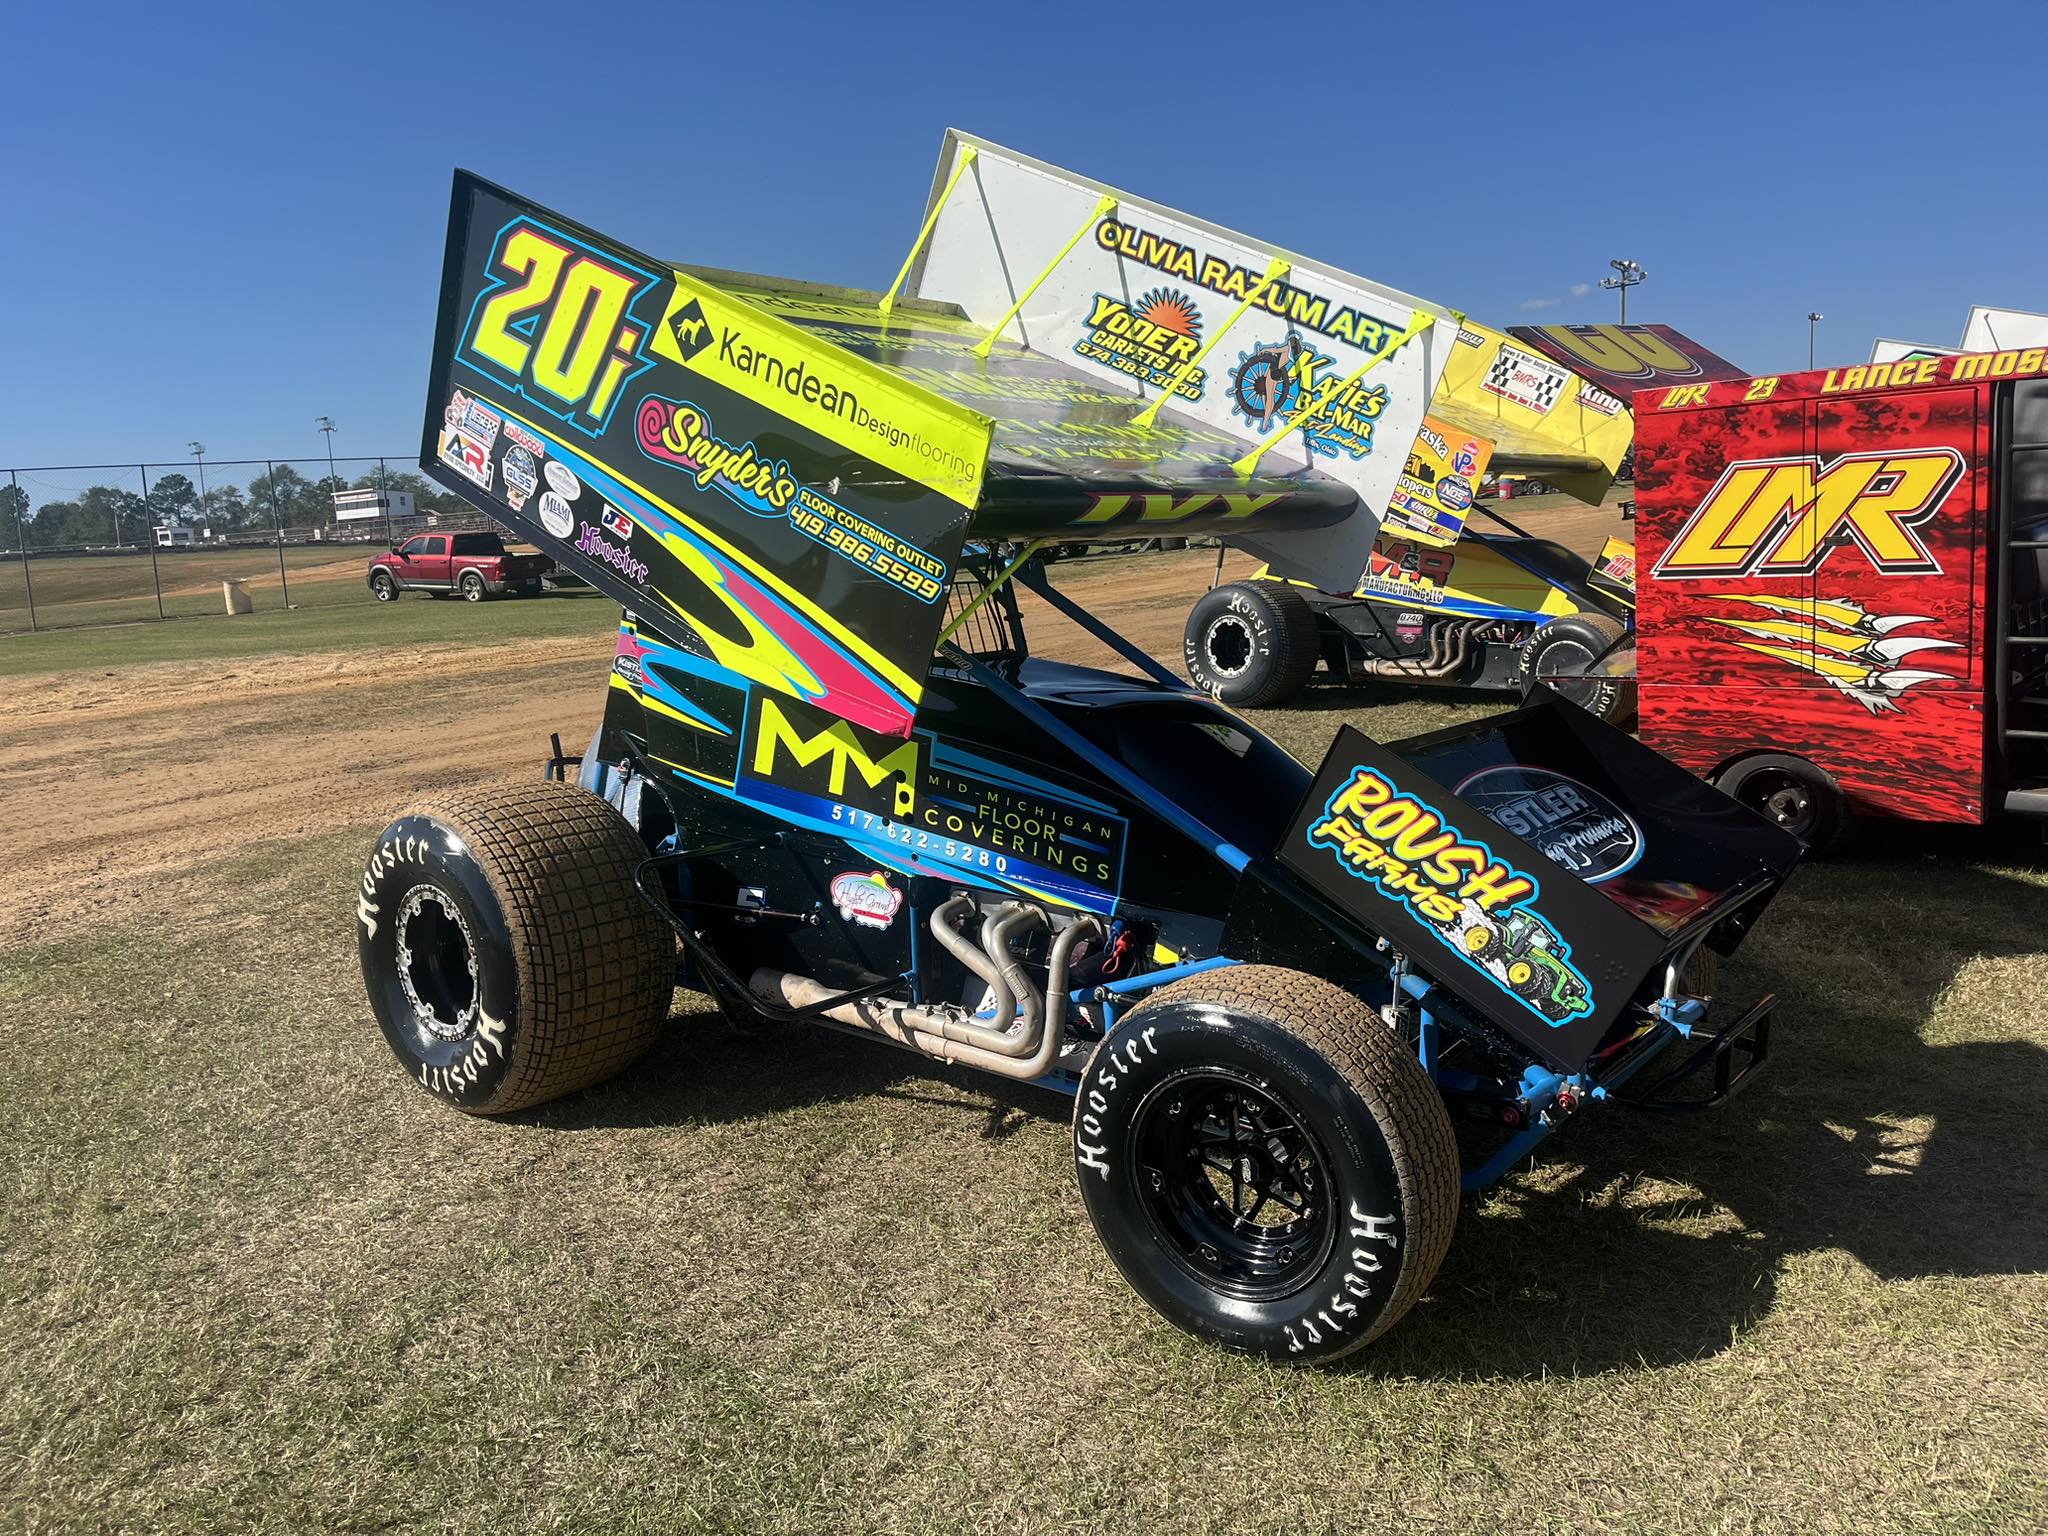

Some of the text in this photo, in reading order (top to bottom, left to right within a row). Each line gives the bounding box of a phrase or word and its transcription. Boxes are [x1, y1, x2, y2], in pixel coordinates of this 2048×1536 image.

[1097, 220, 1408, 357] OLIVIA RAZUM ART
[471, 228, 639, 422] 20i
[1088, 296, 1199, 362] YODER
[1091, 330, 1171, 370] CARPETS
[719, 327, 857, 422] Karndean
[1511, 369, 1539, 389] BMRS
[1660, 384, 1712, 410] LMR
[1744, 377, 1780, 402] 23
[1820, 358, 1940, 394] LANCE
[507, 467, 532, 489] GLSS
[662, 407, 796, 508] Snyder's
[1399, 474, 1435, 498] lopers
[543, 494, 571, 524] MIAMI
[603, 510, 632, 535] JE
[1441, 483, 1468, 501] NOS
[1652, 448, 1964, 577] LMR
[575, 521, 649, 584] Hoosier
[790, 505, 940, 599] 419.986.5599
[800, 489, 943, 578] FLOOR COVERING OUTLET
[1227, 592, 1272, 656] Hoosier
[1520, 625, 1554, 675] Hoosier
[617, 656, 641, 673] KISTL
[1186, 638, 1224, 700] Hoosier
[831, 805, 1007, 872] 517-622-5280
[928, 774, 1111, 839] MID-MICHIGAN
[978, 804, 1056, 842] FLOOR
[1488, 783, 1589, 836] STLER
[923, 808, 1109, 881] COVERINGS
[1313, 816, 1466, 922] FARMS
[1331, 772, 1532, 910] ROUSH
[357, 834, 429, 940] Hoosier
[421, 994, 506, 1099] Hoosier
[1078, 1024, 1158, 1183] Hoosier
[1282, 1200, 1397, 1353] Hoosier
